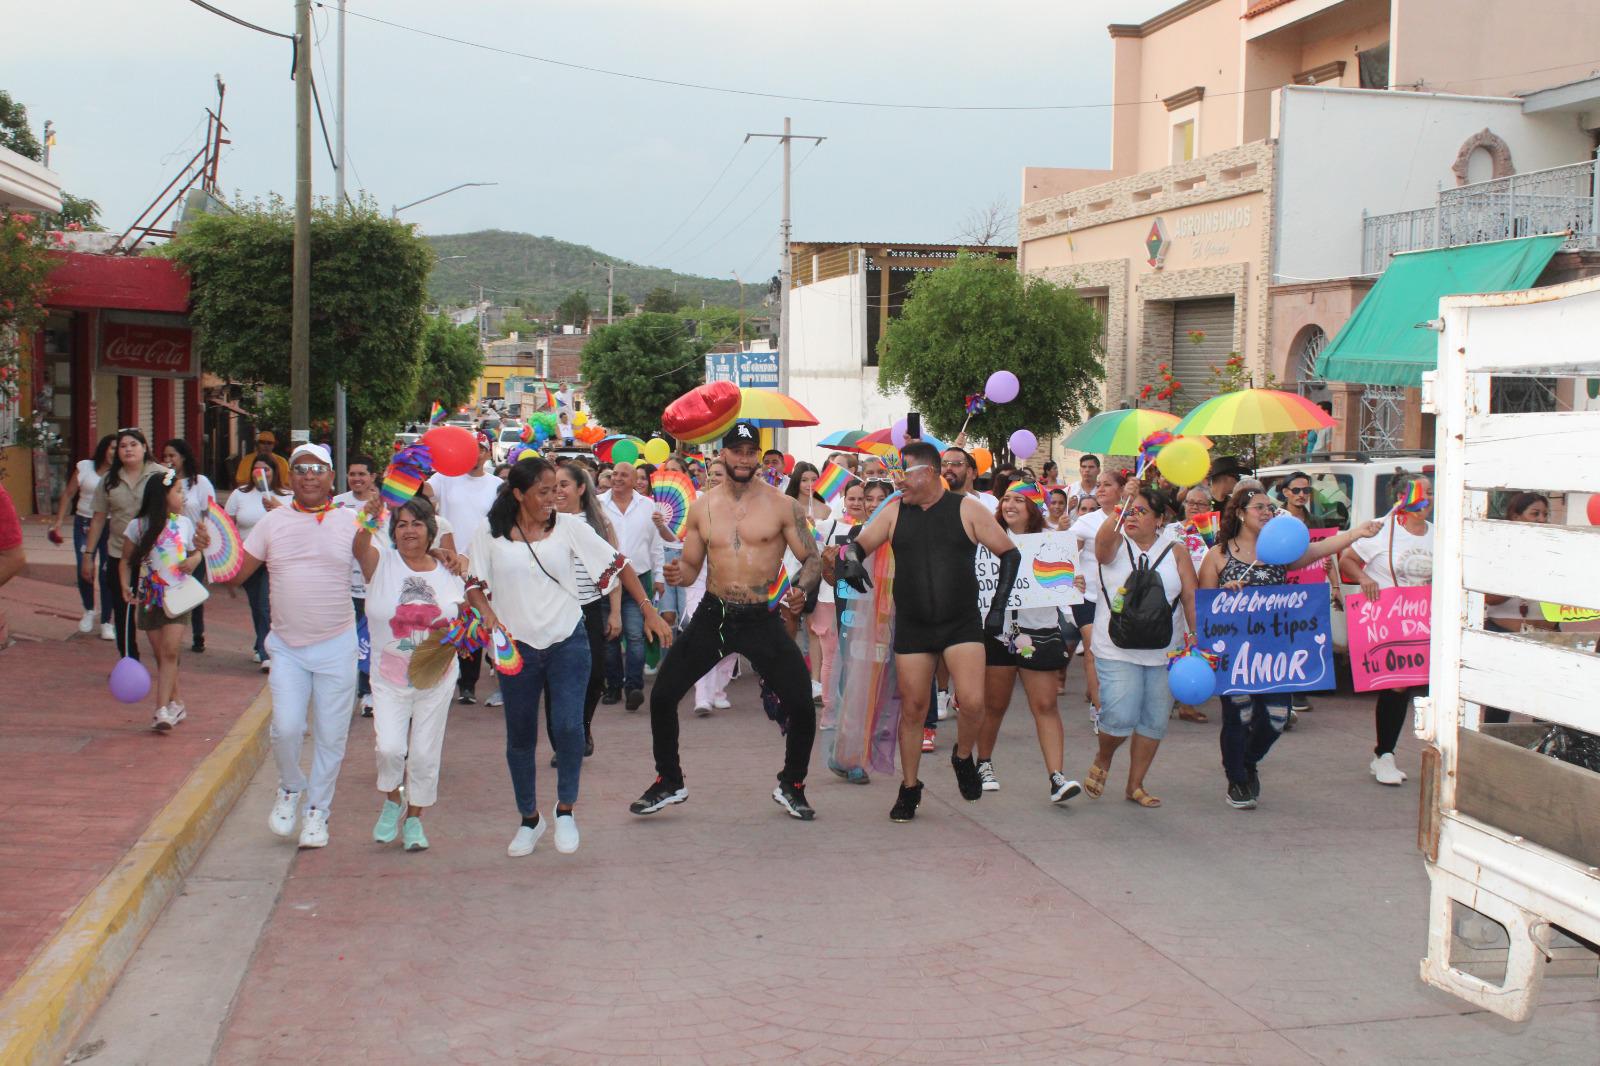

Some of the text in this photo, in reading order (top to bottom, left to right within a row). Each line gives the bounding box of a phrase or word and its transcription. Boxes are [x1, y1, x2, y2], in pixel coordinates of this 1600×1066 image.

[1174, 206, 1250, 237] AGROINSUMOS
[1211, 591, 1308, 614] Celebremos
[1270, 612, 1318, 644] tipos
[1367, 622, 1389, 643] NO
[1231, 641, 1309, 685] AMOR
[1362, 648, 1425, 674] tu ODIO
